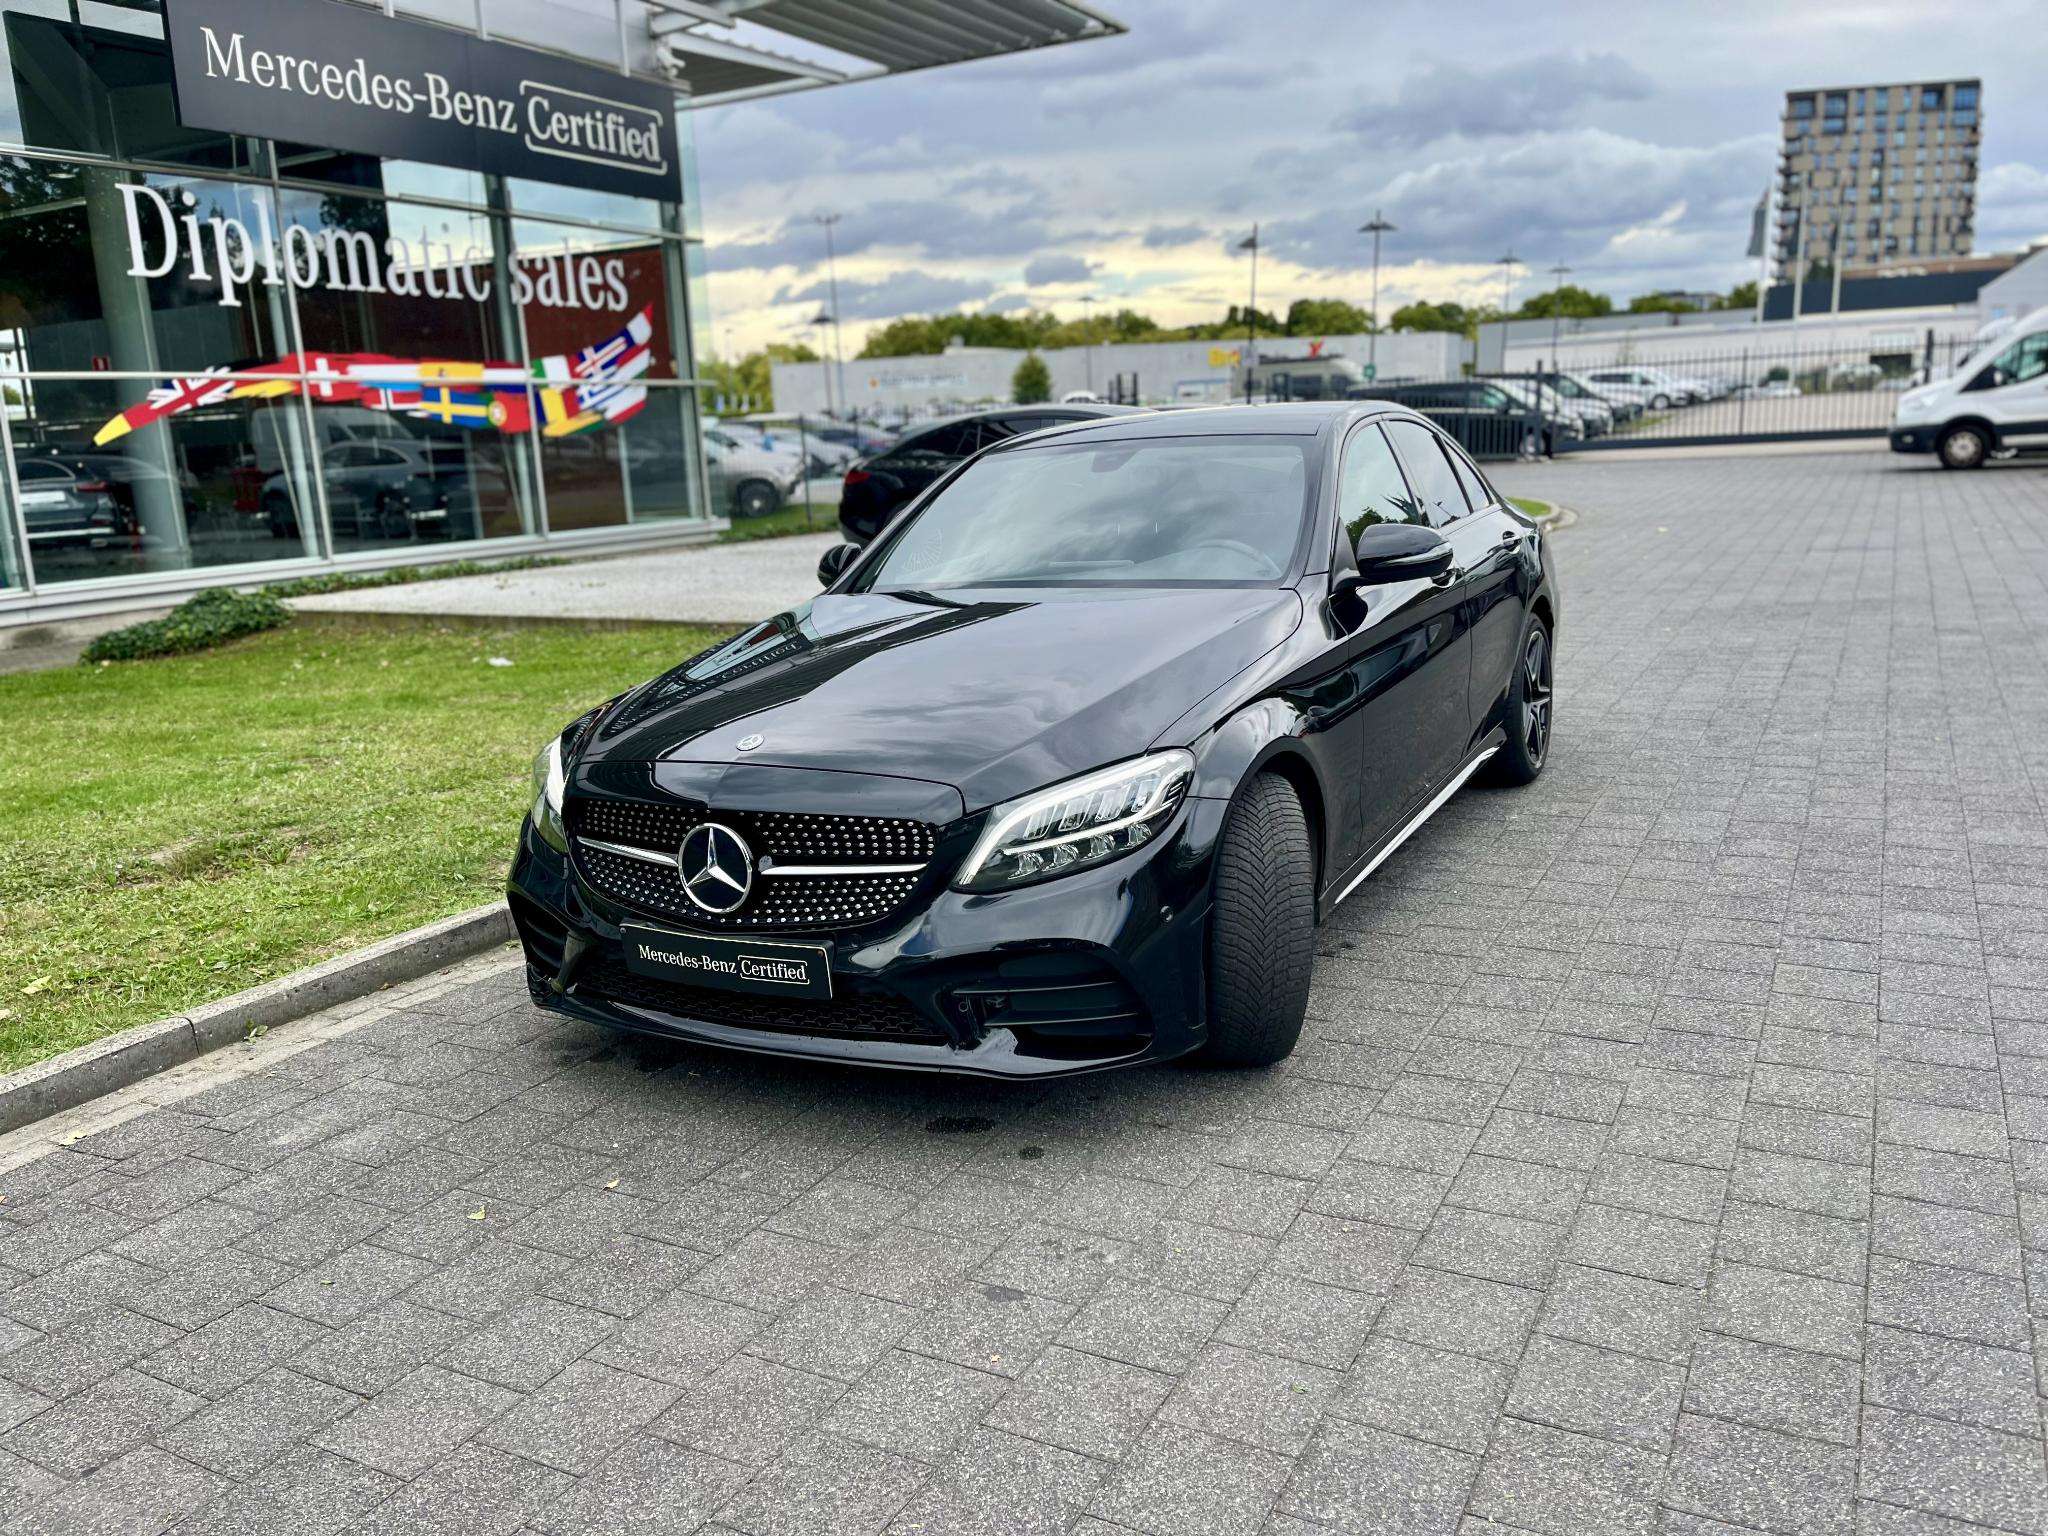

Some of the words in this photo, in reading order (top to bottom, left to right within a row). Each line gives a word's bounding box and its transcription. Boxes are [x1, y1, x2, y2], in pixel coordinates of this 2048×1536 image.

[200, 26, 517, 134] Mercedes-Benz
[527, 95, 662, 162] Certified
[115, 183, 491, 307] Diplomatic
[508, 236, 629, 312] sales
[637, 944, 737, 974] Mercedes-Benz
[741, 959, 807, 980] Certified
